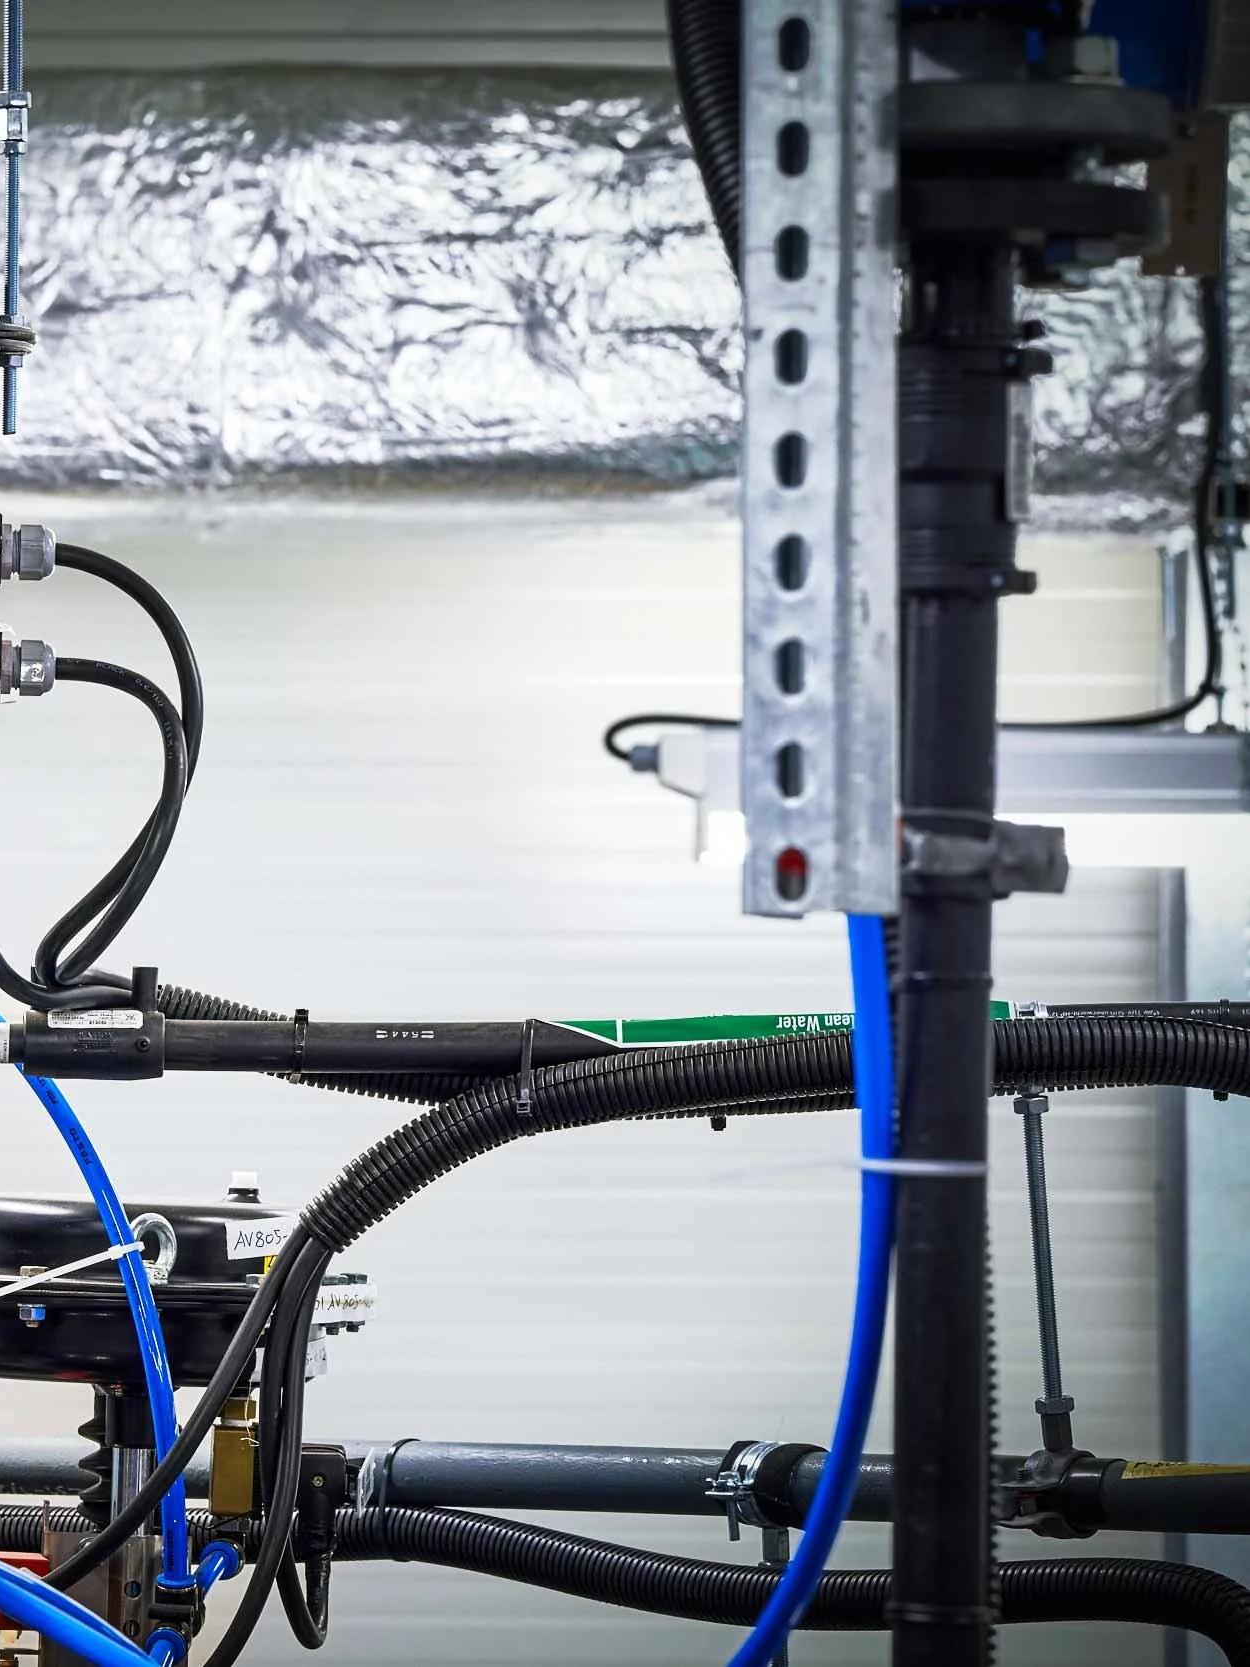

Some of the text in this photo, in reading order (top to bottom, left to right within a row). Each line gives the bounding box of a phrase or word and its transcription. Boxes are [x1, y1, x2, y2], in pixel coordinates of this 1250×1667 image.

[776, 1014, 855, 1031] lean Water
[69, 1126, 93, 1166] FESTO
